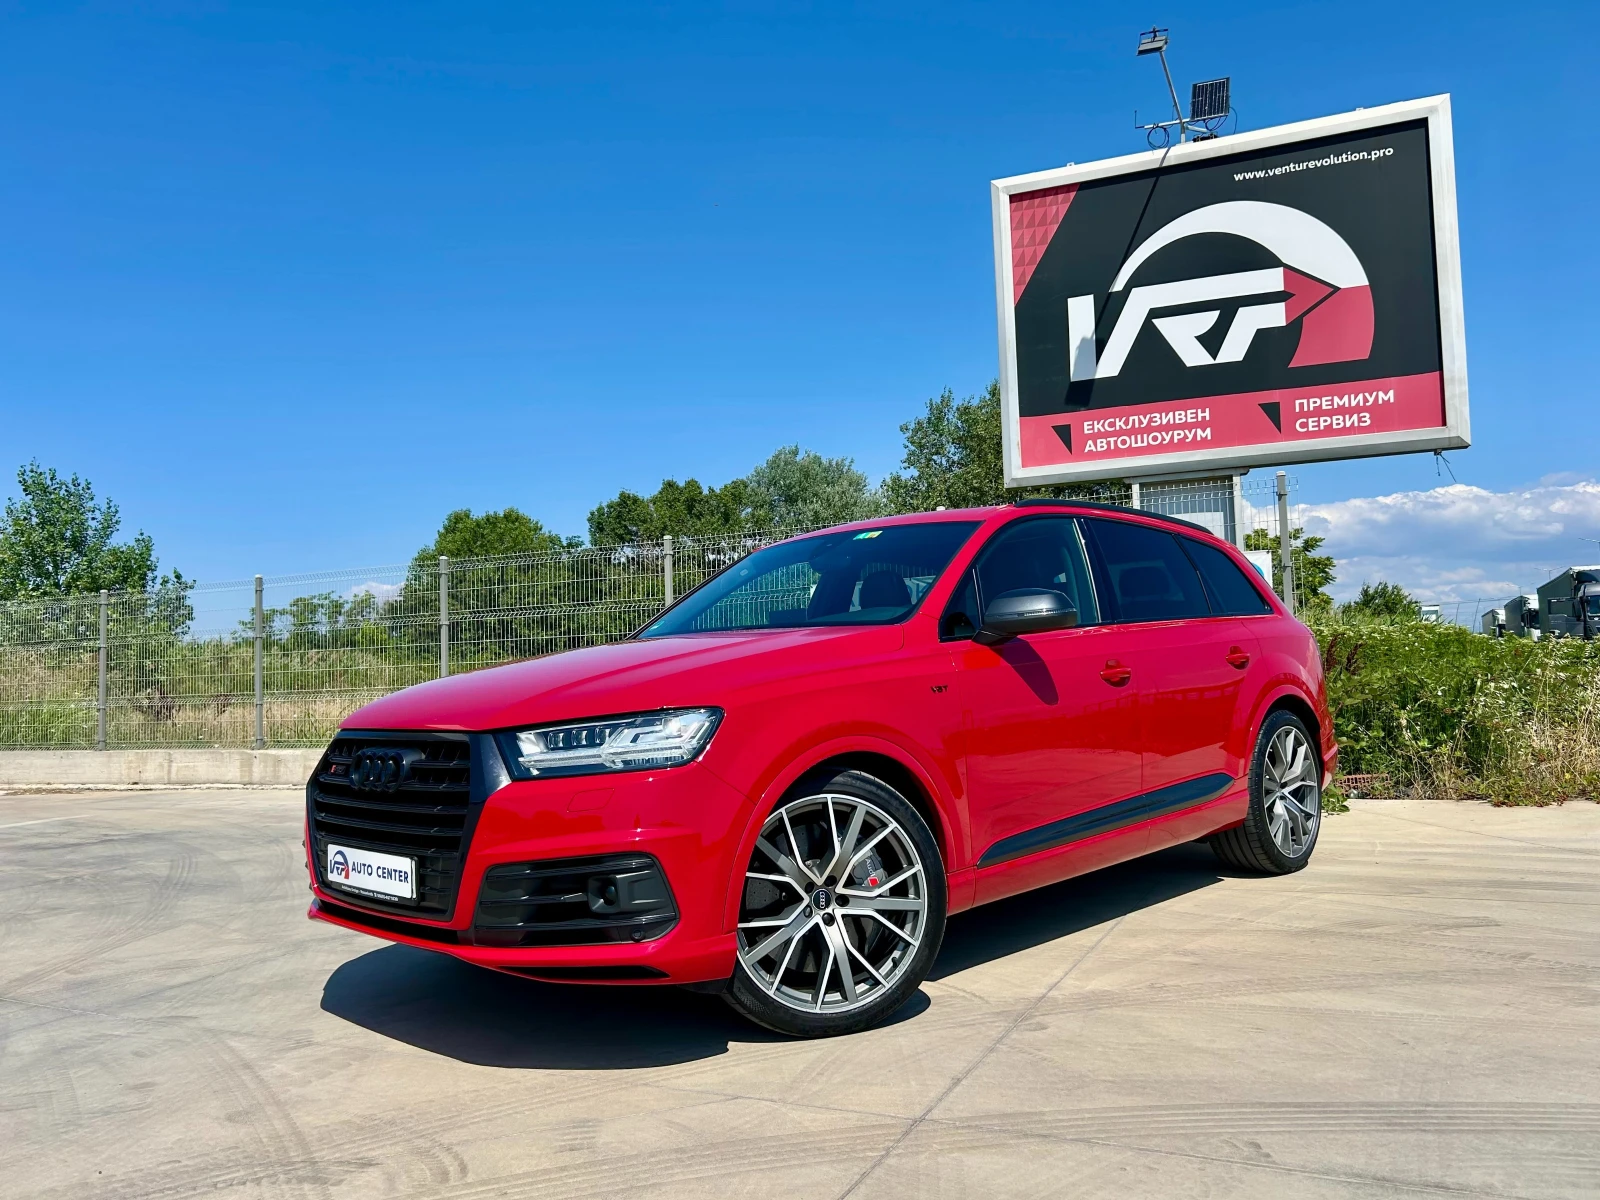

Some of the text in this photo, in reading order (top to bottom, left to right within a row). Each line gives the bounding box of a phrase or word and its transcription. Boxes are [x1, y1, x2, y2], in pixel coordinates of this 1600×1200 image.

[1233, 147, 1394, 182] www.venturevolution.pro
[1294, 390, 1394, 413] ПРЕМИУМ
[1083, 408, 1210, 435] ЕКСКЛУЗИВЕН
[1295, 412, 1371, 433] СЕРВИЗ
[1084, 427, 1212, 453] АВТОШОУРУМ
[351, 861, 409, 884] AUTO CENTER
